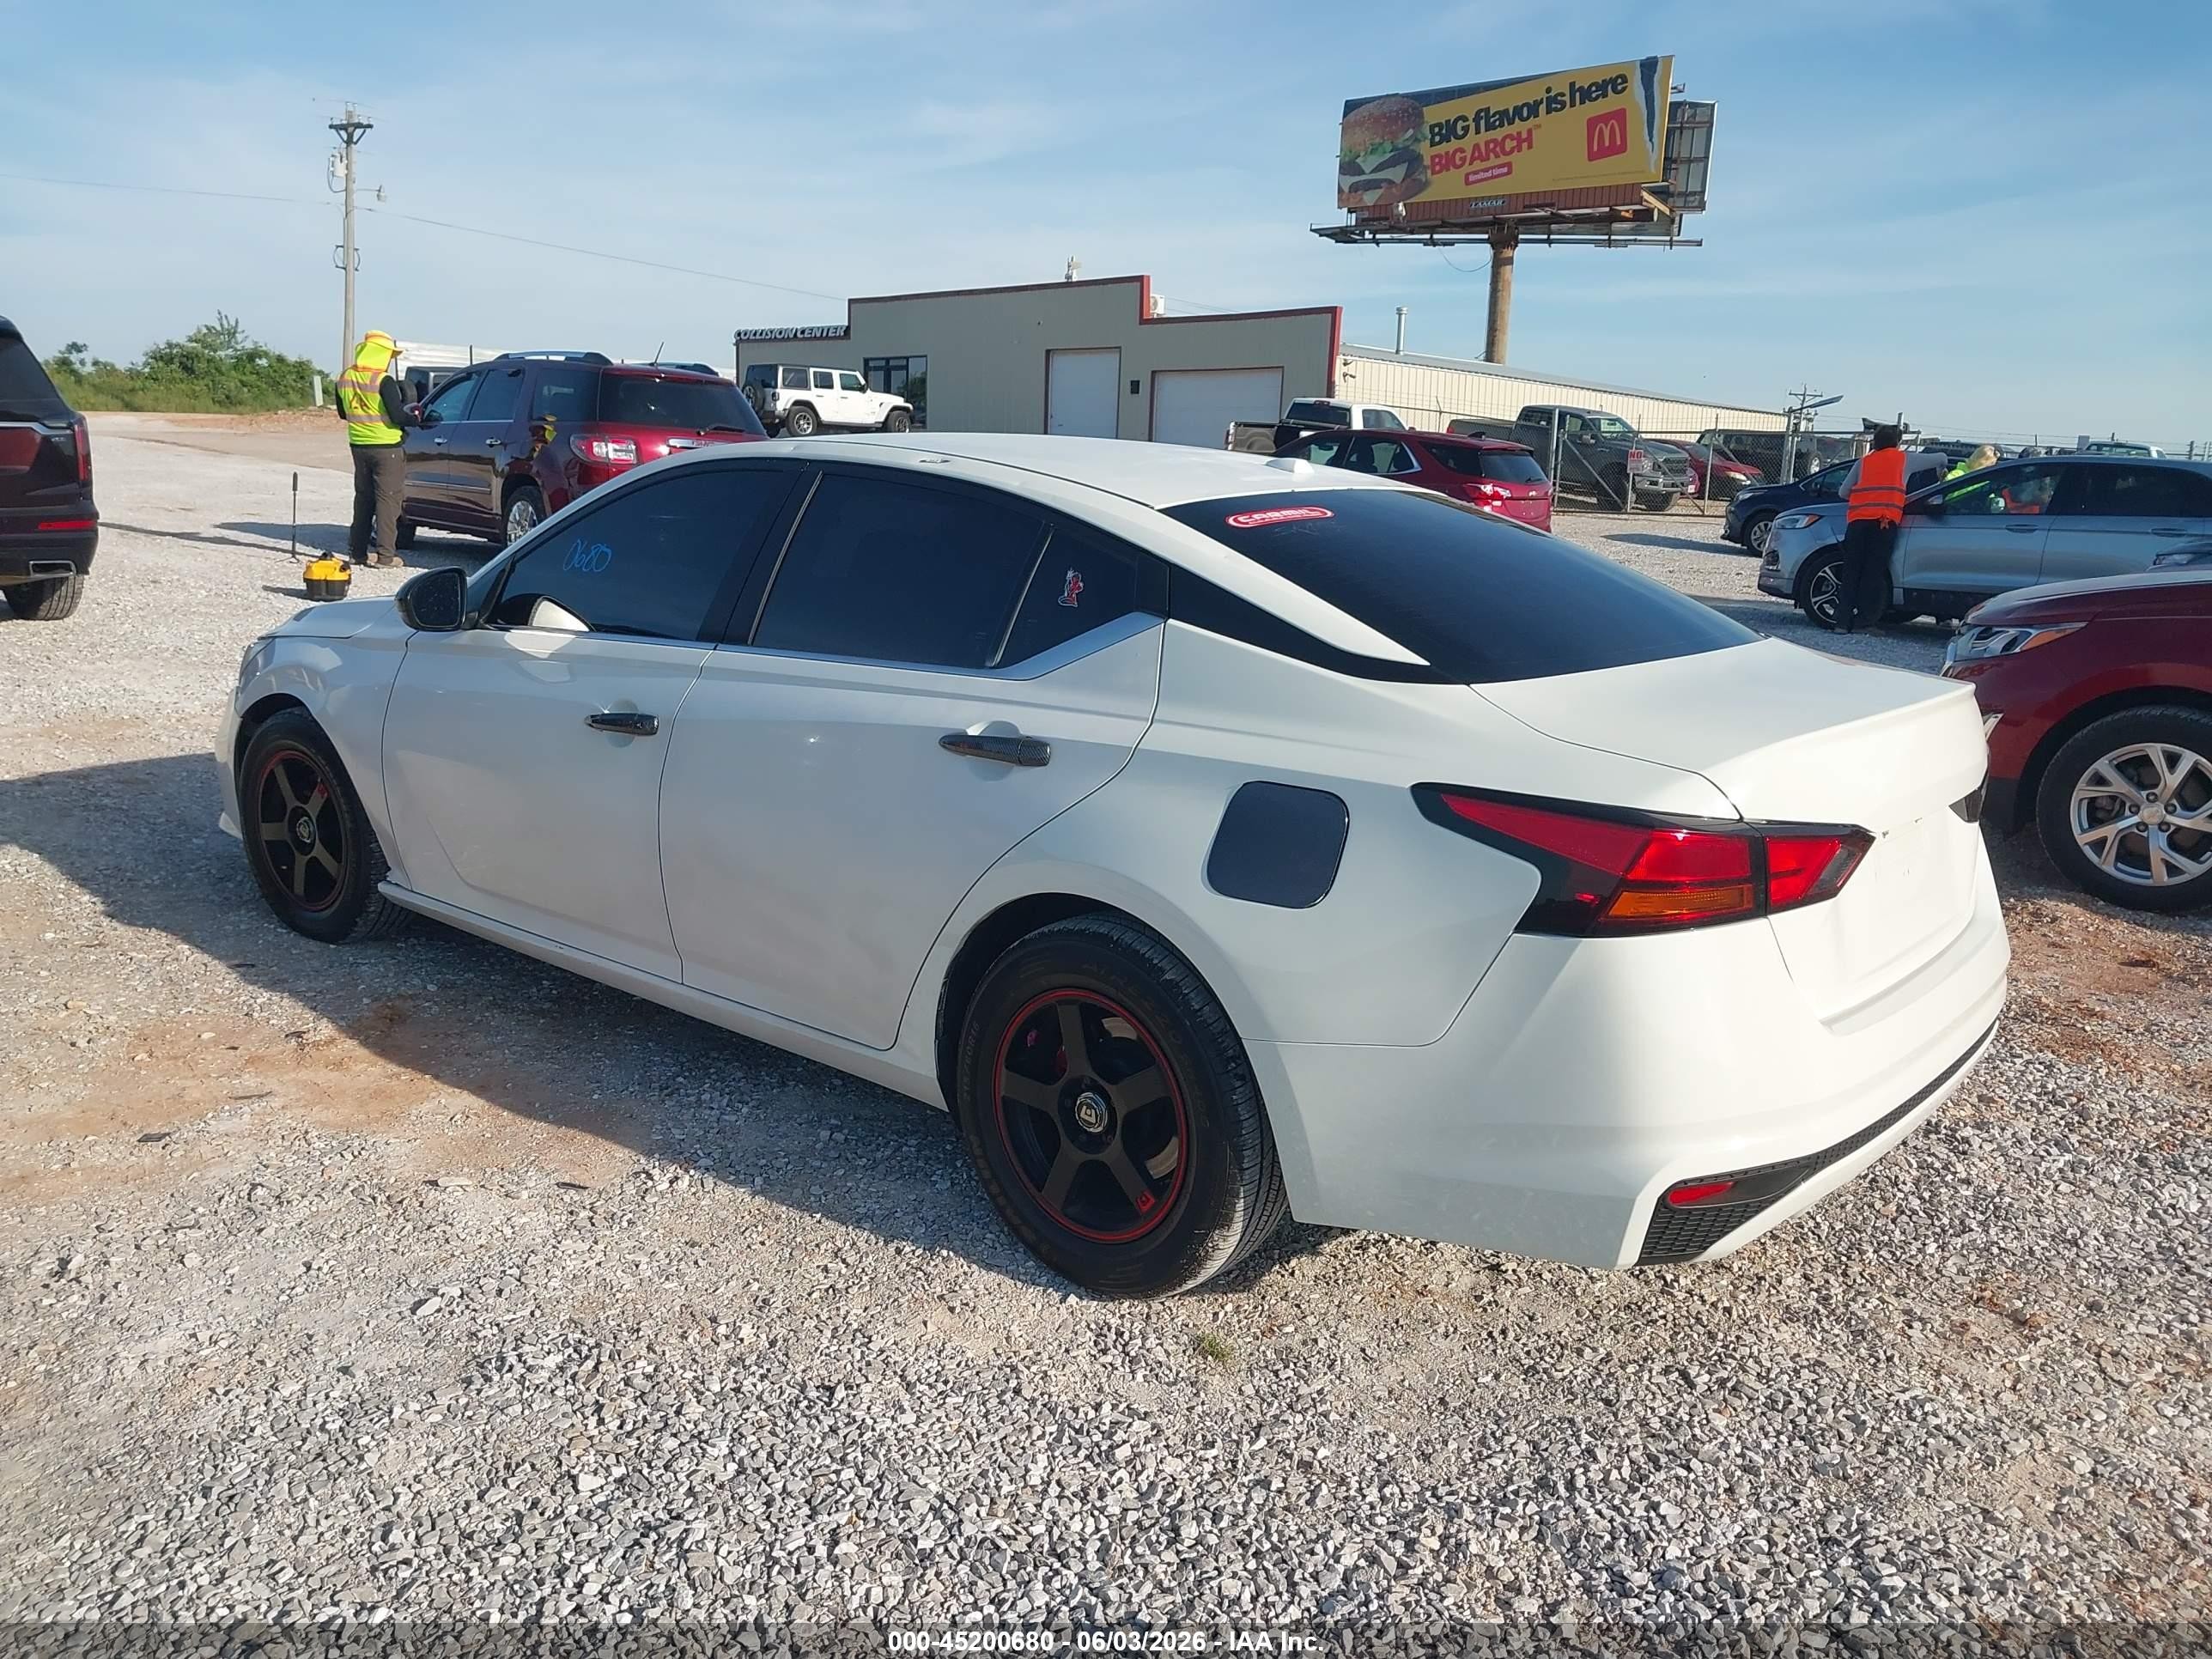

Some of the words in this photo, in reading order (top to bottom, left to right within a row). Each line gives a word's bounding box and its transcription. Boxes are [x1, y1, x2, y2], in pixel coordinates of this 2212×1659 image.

[1429, 114, 1470, 148] BIG
[1473, 96, 1543, 135] flavor
[1546, 87, 1567, 115] is
[1569, 73, 1629, 109] here
[1430, 148, 1468, 175] BIG
[1468, 170, 1492, 182] limited
[1492, 167, 1509, 176] time
[733, 327, 795, 340] COLLISION
[796, 325, 847, 338] CENTER
[1629, 451, 1643, 459] NO
